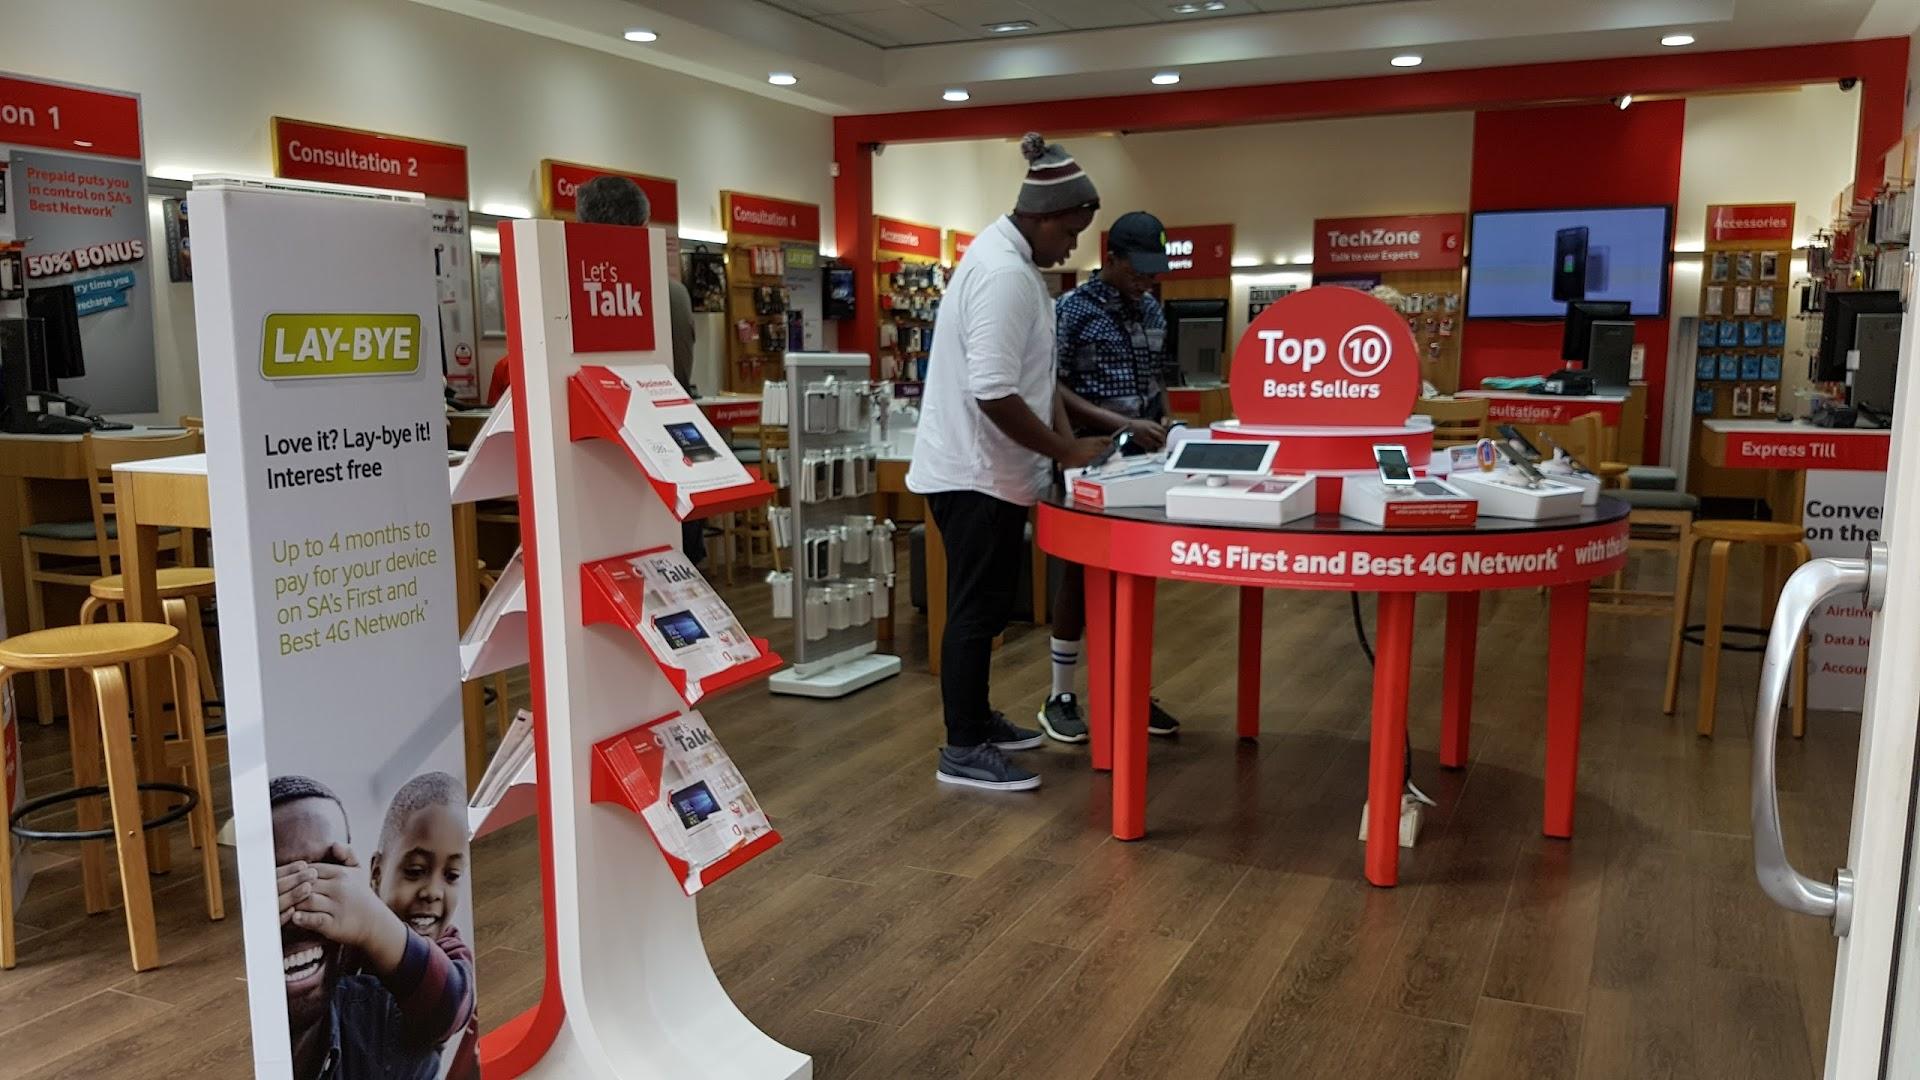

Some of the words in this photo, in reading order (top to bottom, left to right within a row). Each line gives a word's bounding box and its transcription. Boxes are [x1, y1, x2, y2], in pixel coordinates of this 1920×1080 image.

[47, 106, 60, 130] 1
[288, 140, 401, 175] Consultation
[407, 158, 418, 177] 2
[27, 167, 75, 186] Prepaid
[78, 174, 105, 189] puts
[108, 178, 130, 190] you
[28, 184, 40, 194] in
[43, 186, 89, 201] control
[90, 191, 106, 201] on
[107, 192, 132, 205] SA's
[29, 199, 58, 212] Best
[733, 206, 788, 227] Consultation
[1714, 215, 1787, 230] Accessories
[1328, 228, 1421, 248] TechZone
[1446, 235, 1457, 249] 6
[28, 252, 72, 278] 50%
[75, 240, 144, 268] BONUS
[1331, 253, 1350, 262] Talk
[1352, 252, 1362, 262] to
[1363, 253, 1380, 262] our
[1381, 250, 1420, 262] Experts
[581, 259, 618, 283] Let's
[89, 279, 112, 290] time
[582, 282, 643, 317] Talk
[275, 327, 412, 363] LAY-BYE
[1258, 330, 1327, 373] Top
[1348, 337, 1383, 365] 10
[1263, 379, 1307, 398] Best
[1310, 379, 1381, 399] Sellers
[1552, 404, 1563, 419] 7
[265, 434, 312, 457] Love
[317, 429, 339, 451] it?
[343, 424, 412, 452] Lay-bye
[415, 422, 431, 442] it!
[1741, 441, 1805, 460] Express
[1809, 441, 1837, 459] Till
[267, 461, 343, 490] Interest
[347, 459, 383, 480] free
[272, 540, 299, 567] Up
[305, 537, 324, 558] to
[328, 532, 341, 553] 4
[346, 522, 410, 551] months
[415, 520, 430, 539] to
[1806, 526, 1833, 540] on
[1839, 524, 1879, 542] the
[1170, 539, 1222, 568] SA's
[1226, 544, 1289, 572] First
[1292, 550, 1346, 576] and
[1352, 551, 1416, 577] Best
[1419, 552, 1456, 577] 4G
[1574, 539, 1605, 565] with
[275, 572, 309, 600] pay
[313, 564, 338, 587] for
[342, 559, 382, 588] your
[386, 547, 437, 573] device
[657, 564, 697, 584] Talk
[277, 605, 302, 625] on
[306, 592, 343, 620] SA's
[346, 587, 383, 610] First
[387, 575, 417, 600] and
[280, 628, 321, 656] Best
[325, 620, 350, 644] 4G
[1824, 633, 1854, 646] Data
[675, 727, 713, 752] Talk
